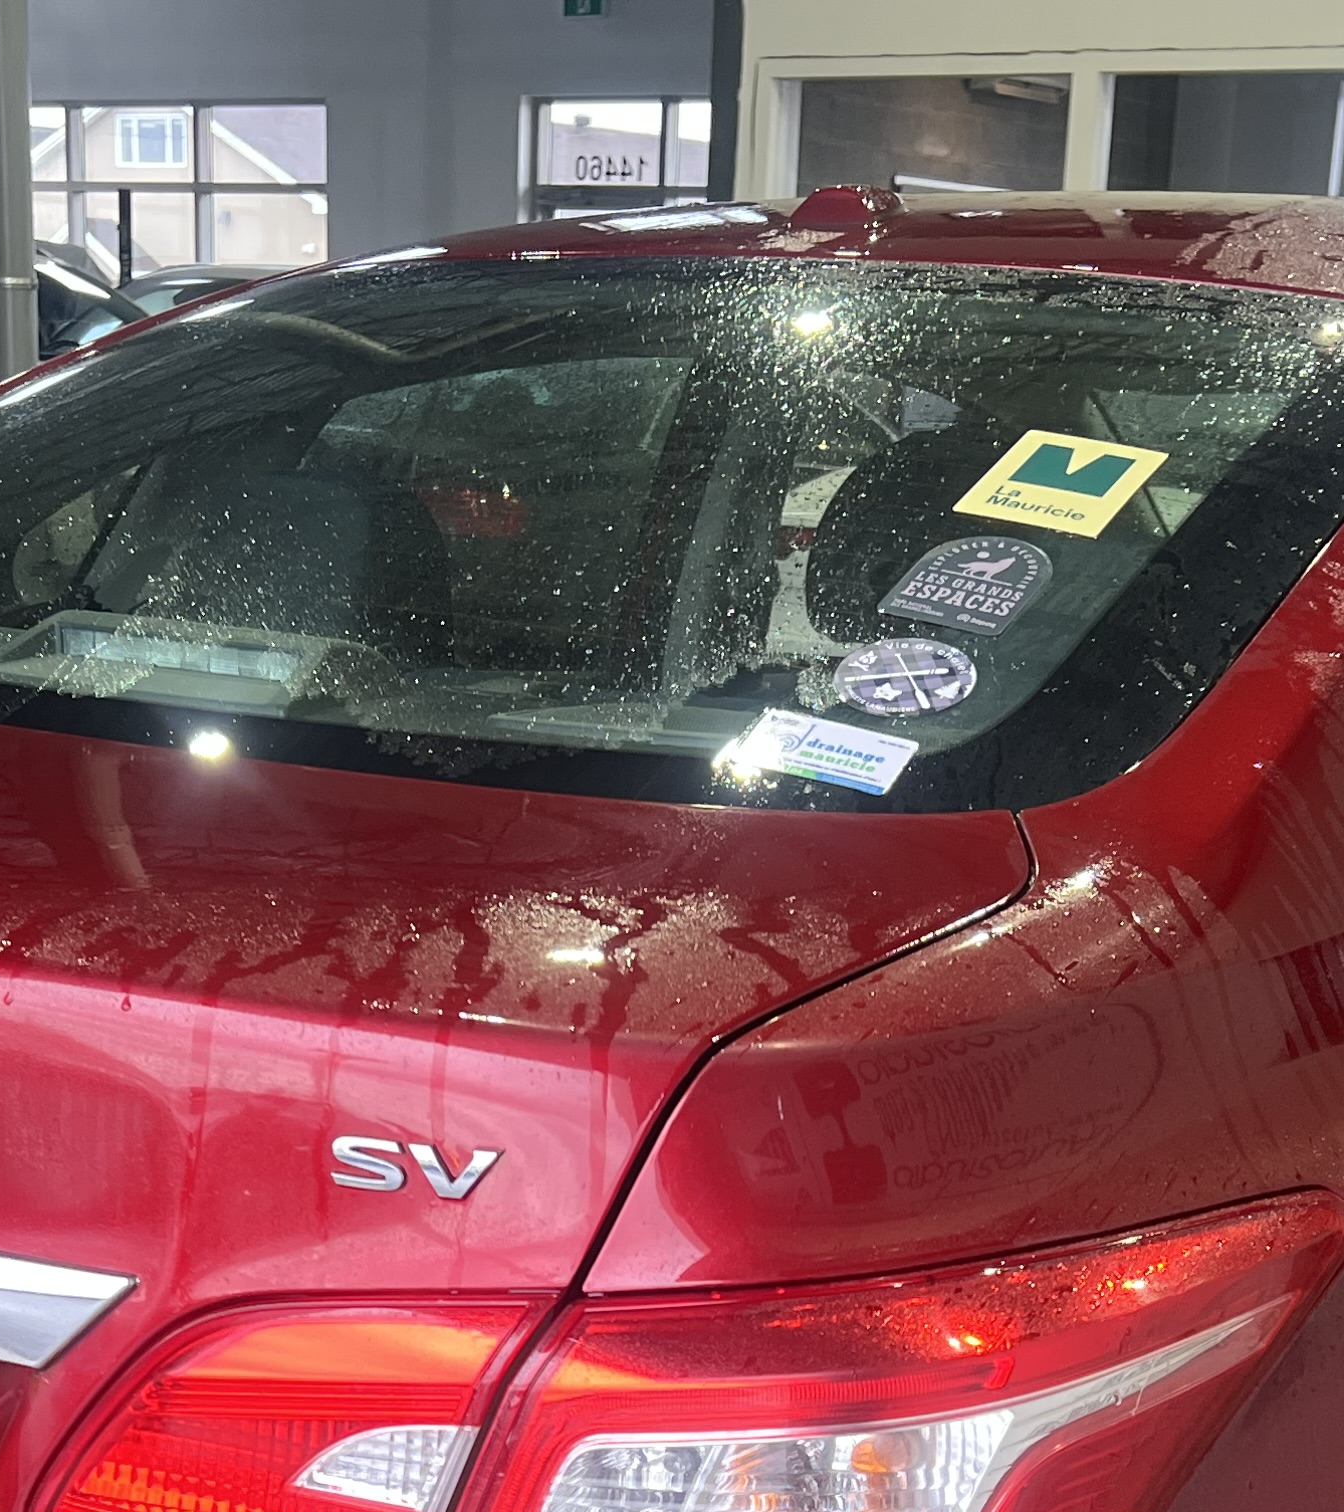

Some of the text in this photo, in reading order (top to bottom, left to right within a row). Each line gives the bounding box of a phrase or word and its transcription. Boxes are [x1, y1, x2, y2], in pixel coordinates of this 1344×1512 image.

[994, 485, 1021, 497] La
[985, 494, 1086, 521] Mauricie
[900, 581, 1015, 617] ESPACES
[915, 571, 1024, 601] LES GRANDS
[915, 643, 934, 652] de
[937, 649, 969, 675] chalet
[799, 750, 876, 773] mauricie
[807, 738, 885, 764] drainage
[331, 1135, 505, 1200] SV
